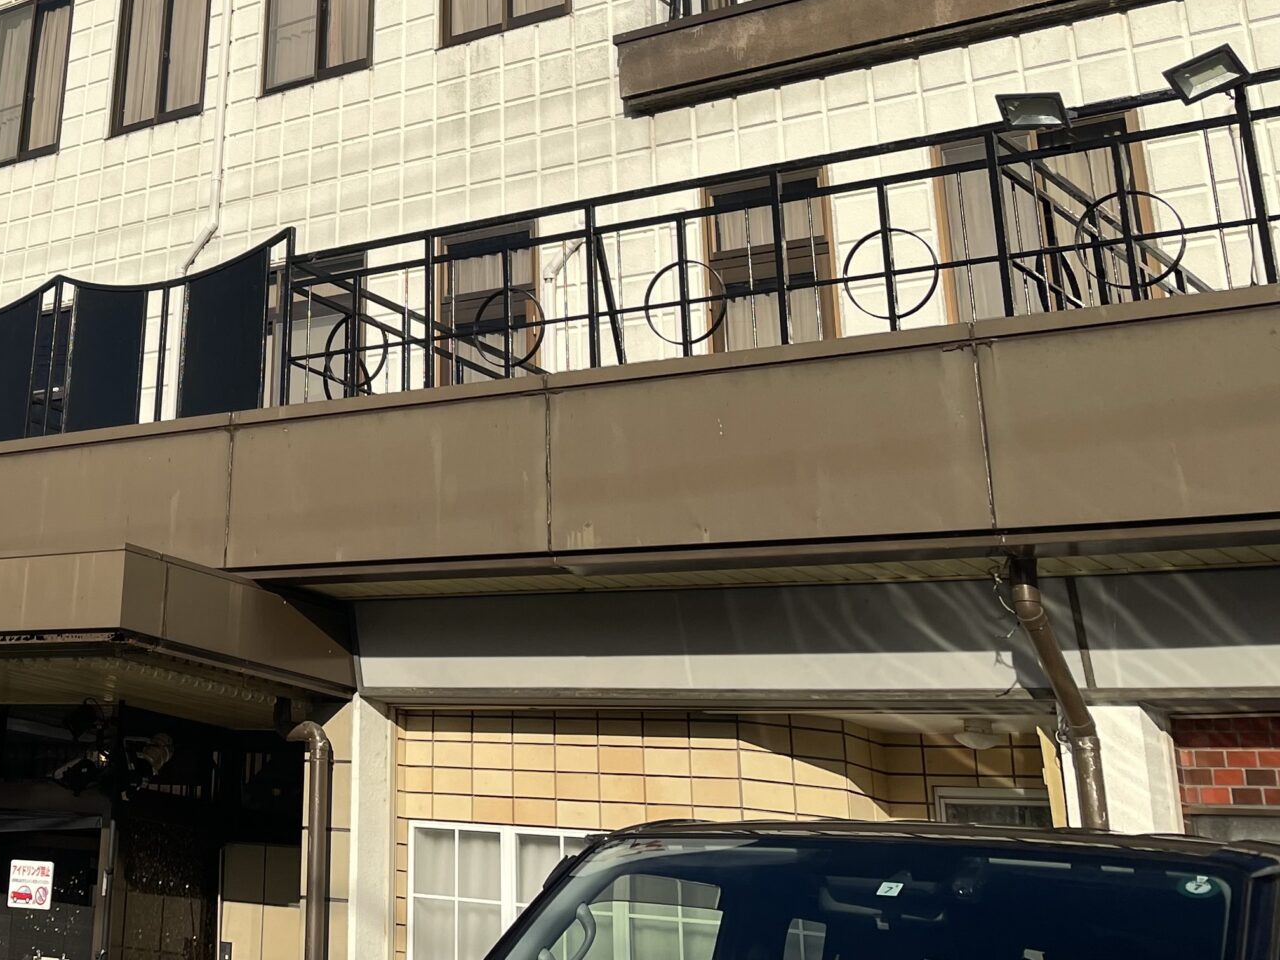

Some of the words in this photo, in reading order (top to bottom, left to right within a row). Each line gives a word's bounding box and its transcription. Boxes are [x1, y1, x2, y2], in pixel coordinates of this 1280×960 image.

[11, 865, 51, 877] アイドリング禁止
